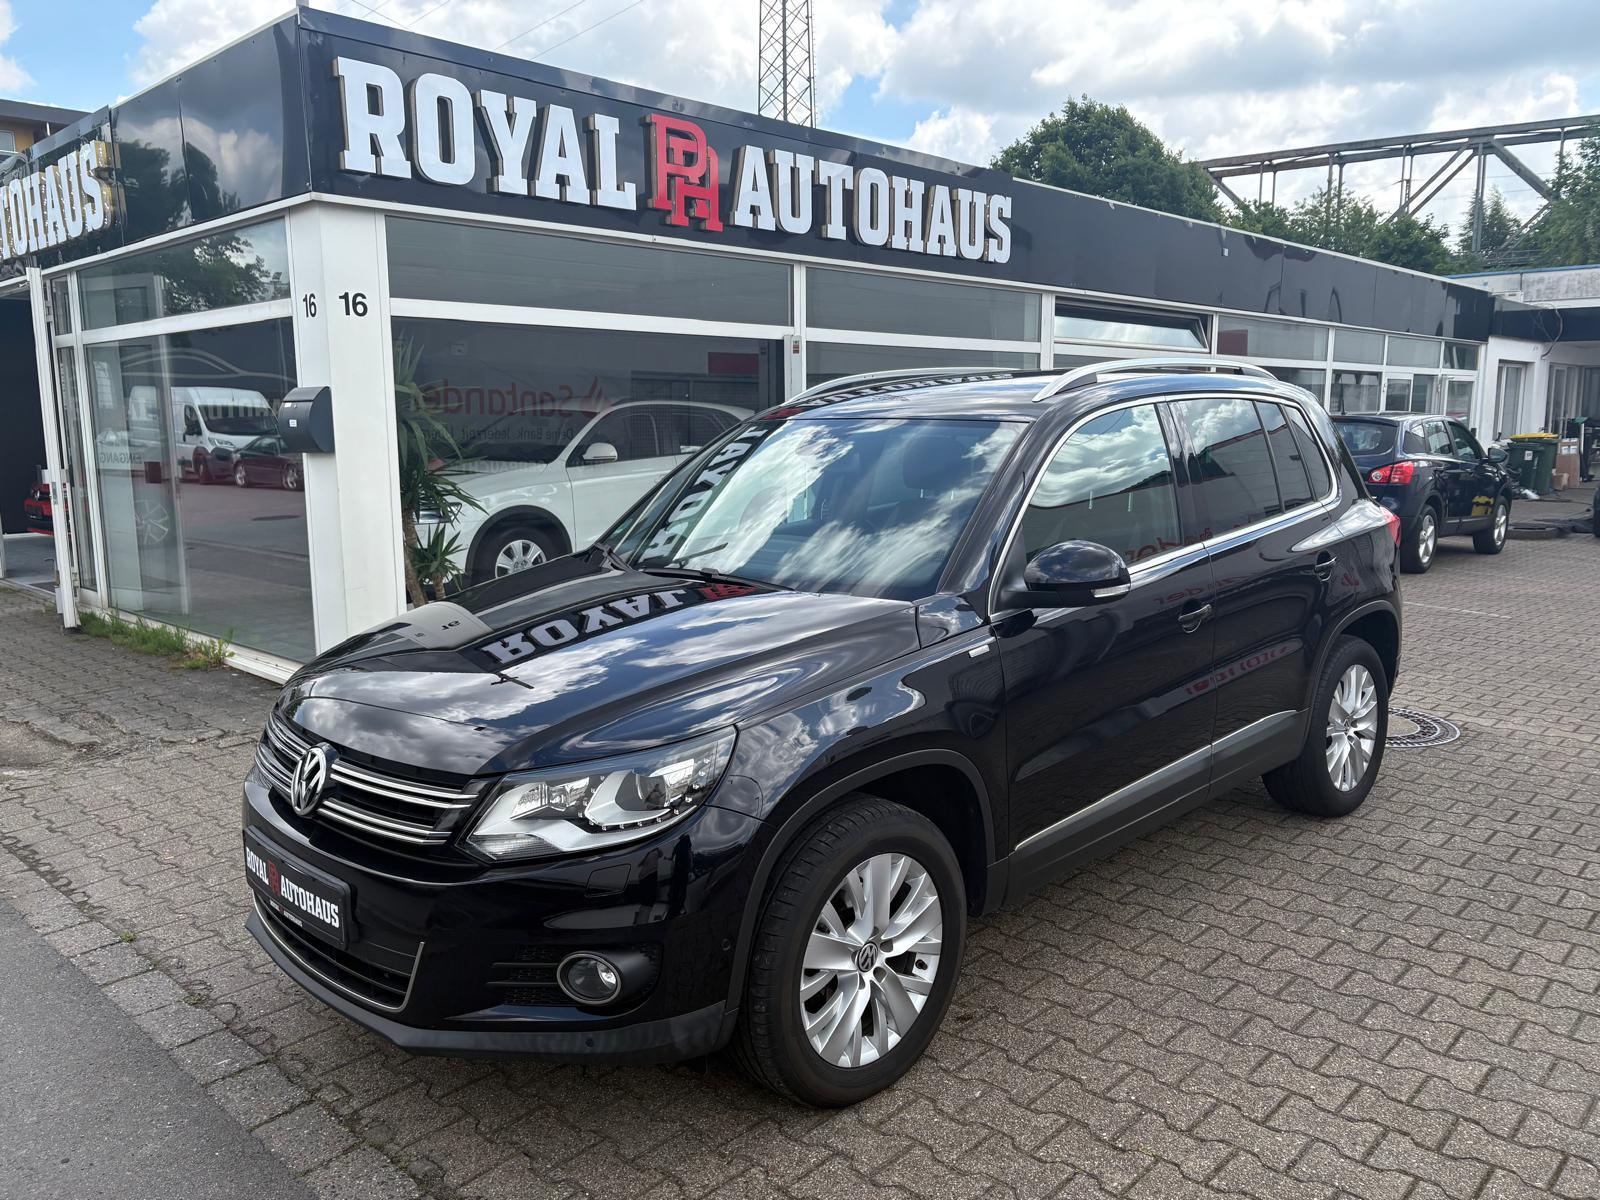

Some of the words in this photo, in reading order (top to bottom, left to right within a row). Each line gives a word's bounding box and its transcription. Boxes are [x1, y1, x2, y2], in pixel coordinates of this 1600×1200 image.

[333, 55, 637, 211] ROYAL
[731, 144, 1012, 264] AUTOHAUS
[302, 293, 317, 318] 16
[338, 291, 368, 317] 16
[246, 846, 270, 886] ROYAL
[280, 874, 341, 929] AUTOHAUS
